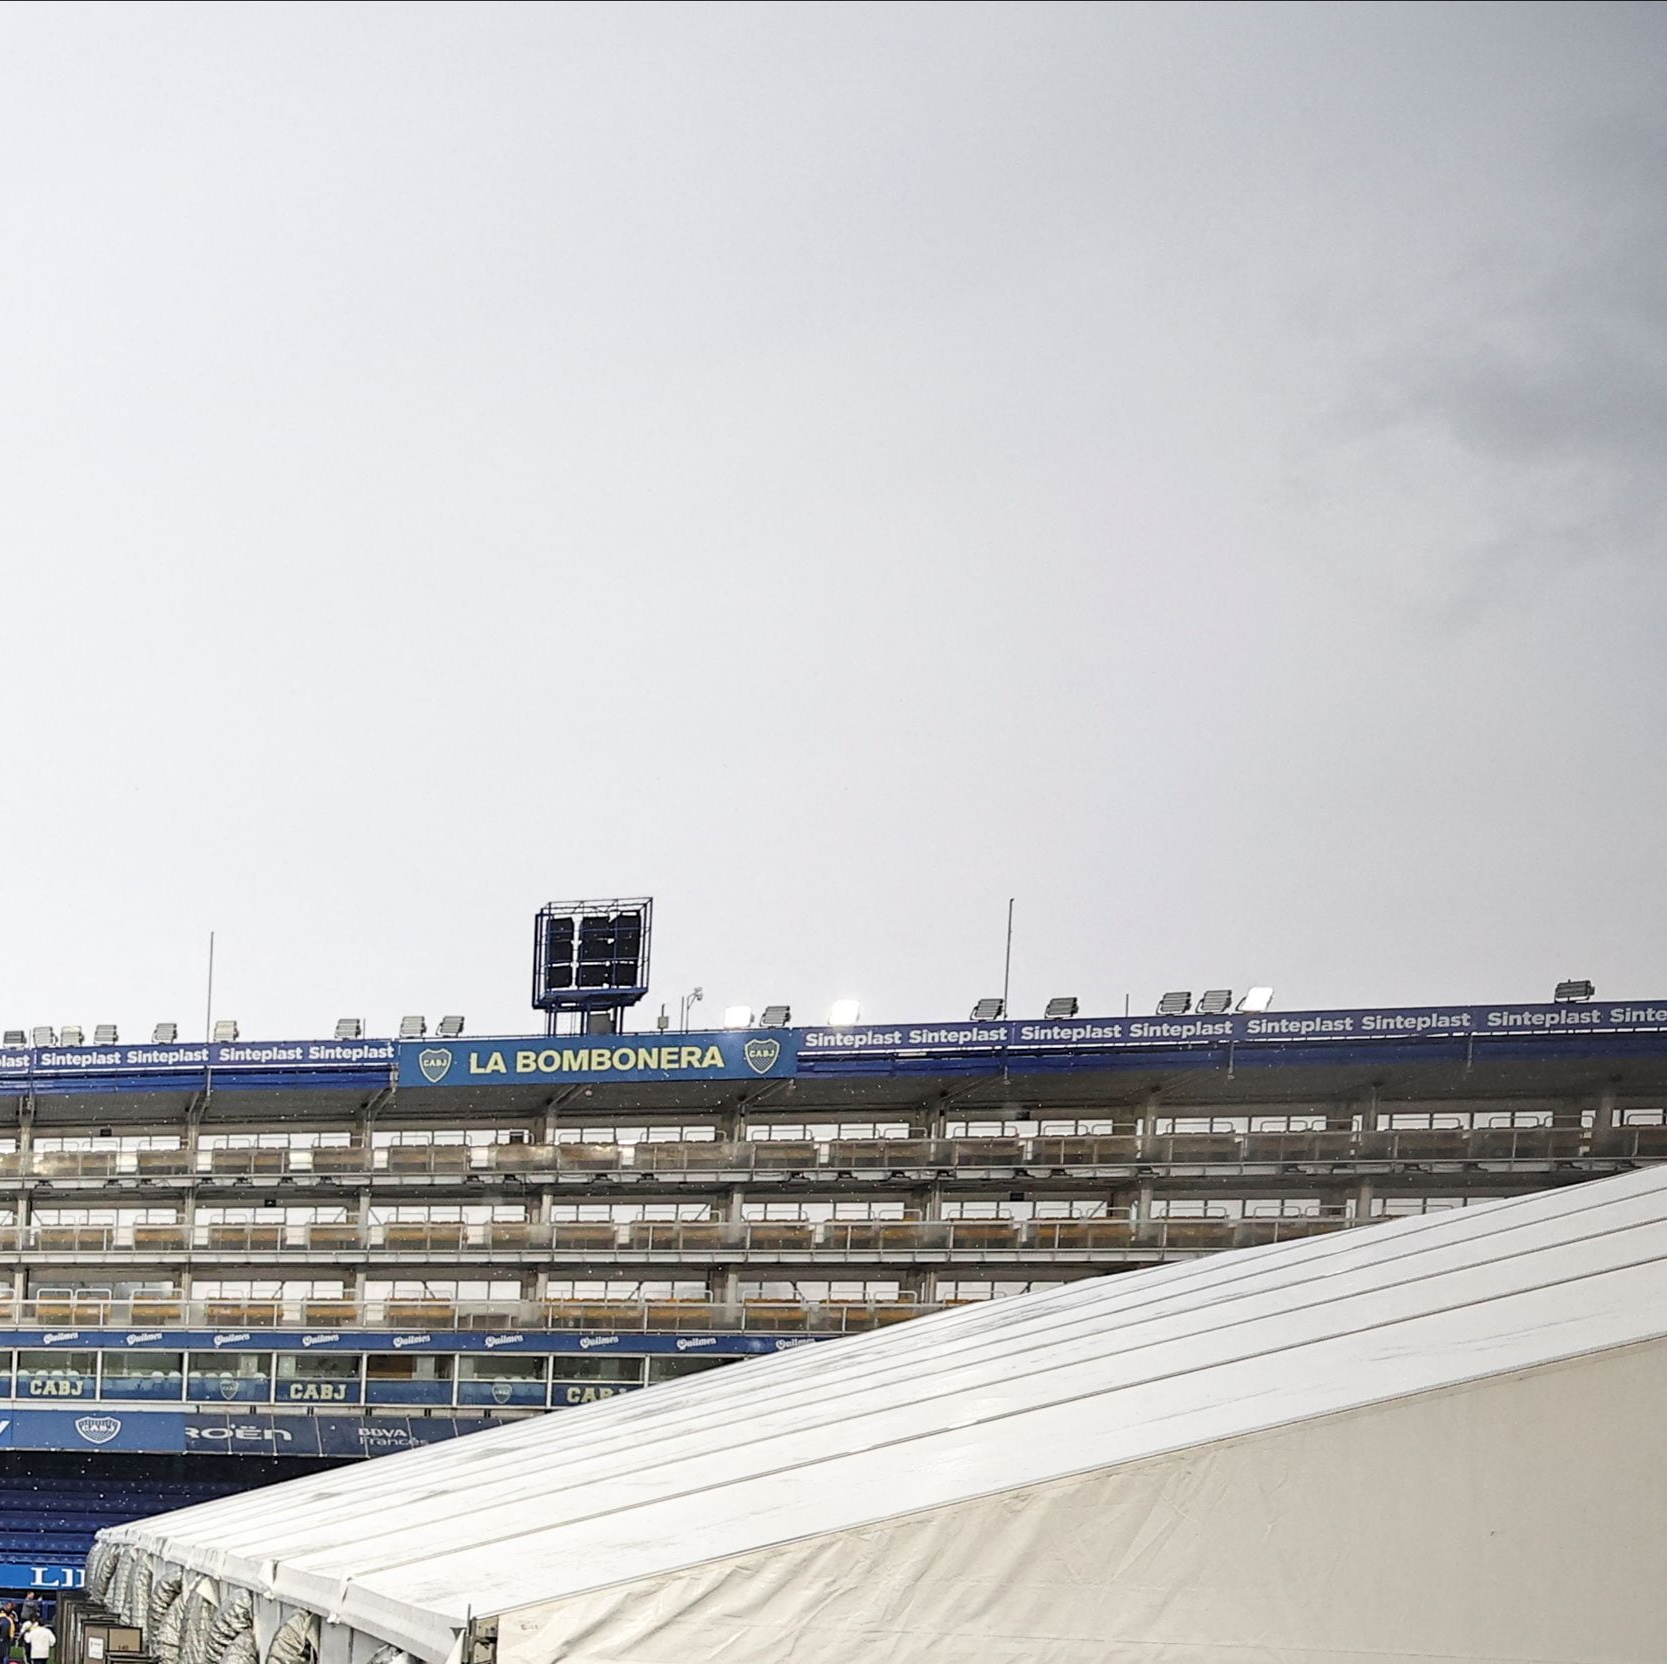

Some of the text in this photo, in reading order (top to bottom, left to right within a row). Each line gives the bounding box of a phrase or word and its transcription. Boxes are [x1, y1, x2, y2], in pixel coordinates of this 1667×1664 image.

[805, 1030, 901, 1048] Sinteplast
[909, 1027, 1007, 1045] Sinteplast
[1021, 1023, 1122, 1041] Sinteplast
[1129, 1020, 1233, 1039] Sinteplast
[1247, 1016, 1353, 1035] Sinteplast
[1361, 1013, 1471, 1031] Sinteplast
[1487, 1009, 1601, 1028] Sinteplast
[41, 1051, 121, 1068] Sinteplast
[127, 1048, 209, 1065] Sinteplast
[219, 1046, 302, 1063] Sinteplast
[309, 1045, 394, 1061] Sinteplast
[469, 1045, 725, 1074] LA BOMBONERA
[29, 1379, 84, 1396] CABJ
[290, 1384, 347, 1400] CABJ
